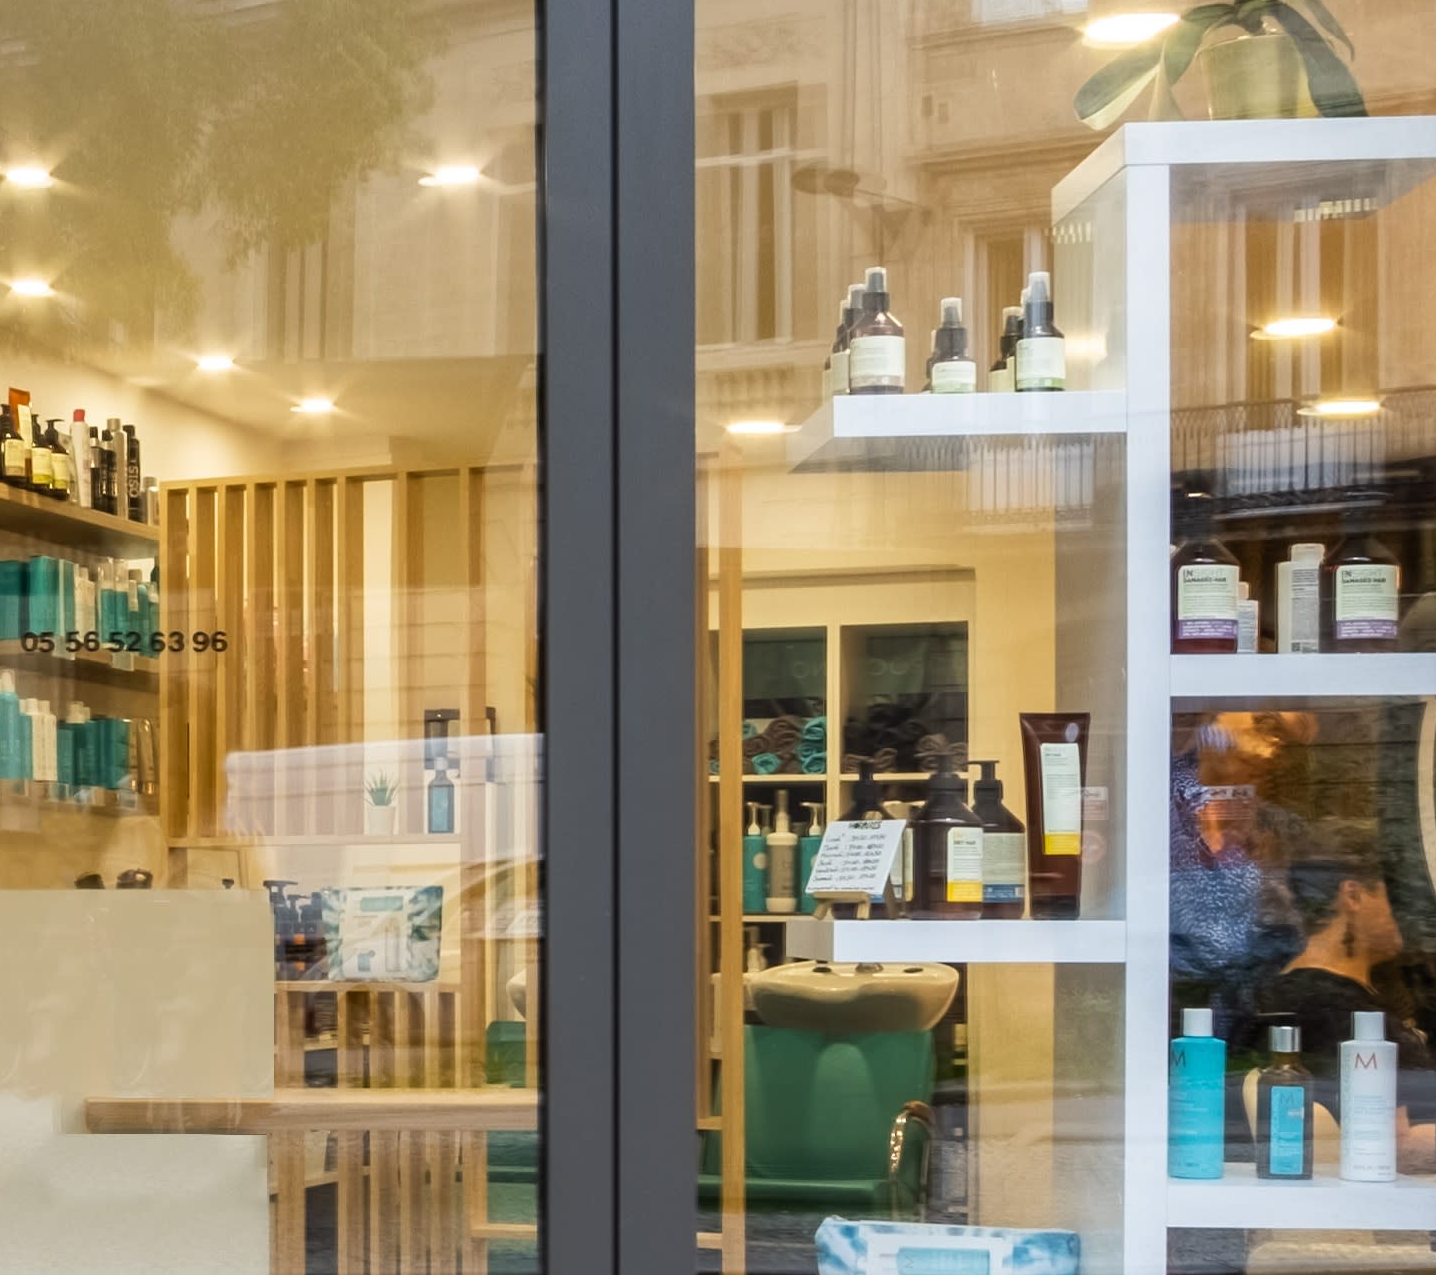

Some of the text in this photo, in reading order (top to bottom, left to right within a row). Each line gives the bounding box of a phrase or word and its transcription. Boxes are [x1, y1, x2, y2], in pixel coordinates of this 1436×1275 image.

[20, 631, 229, 653] 05 56 52 63 96
[1354, 1052, 1379, 1070] M
